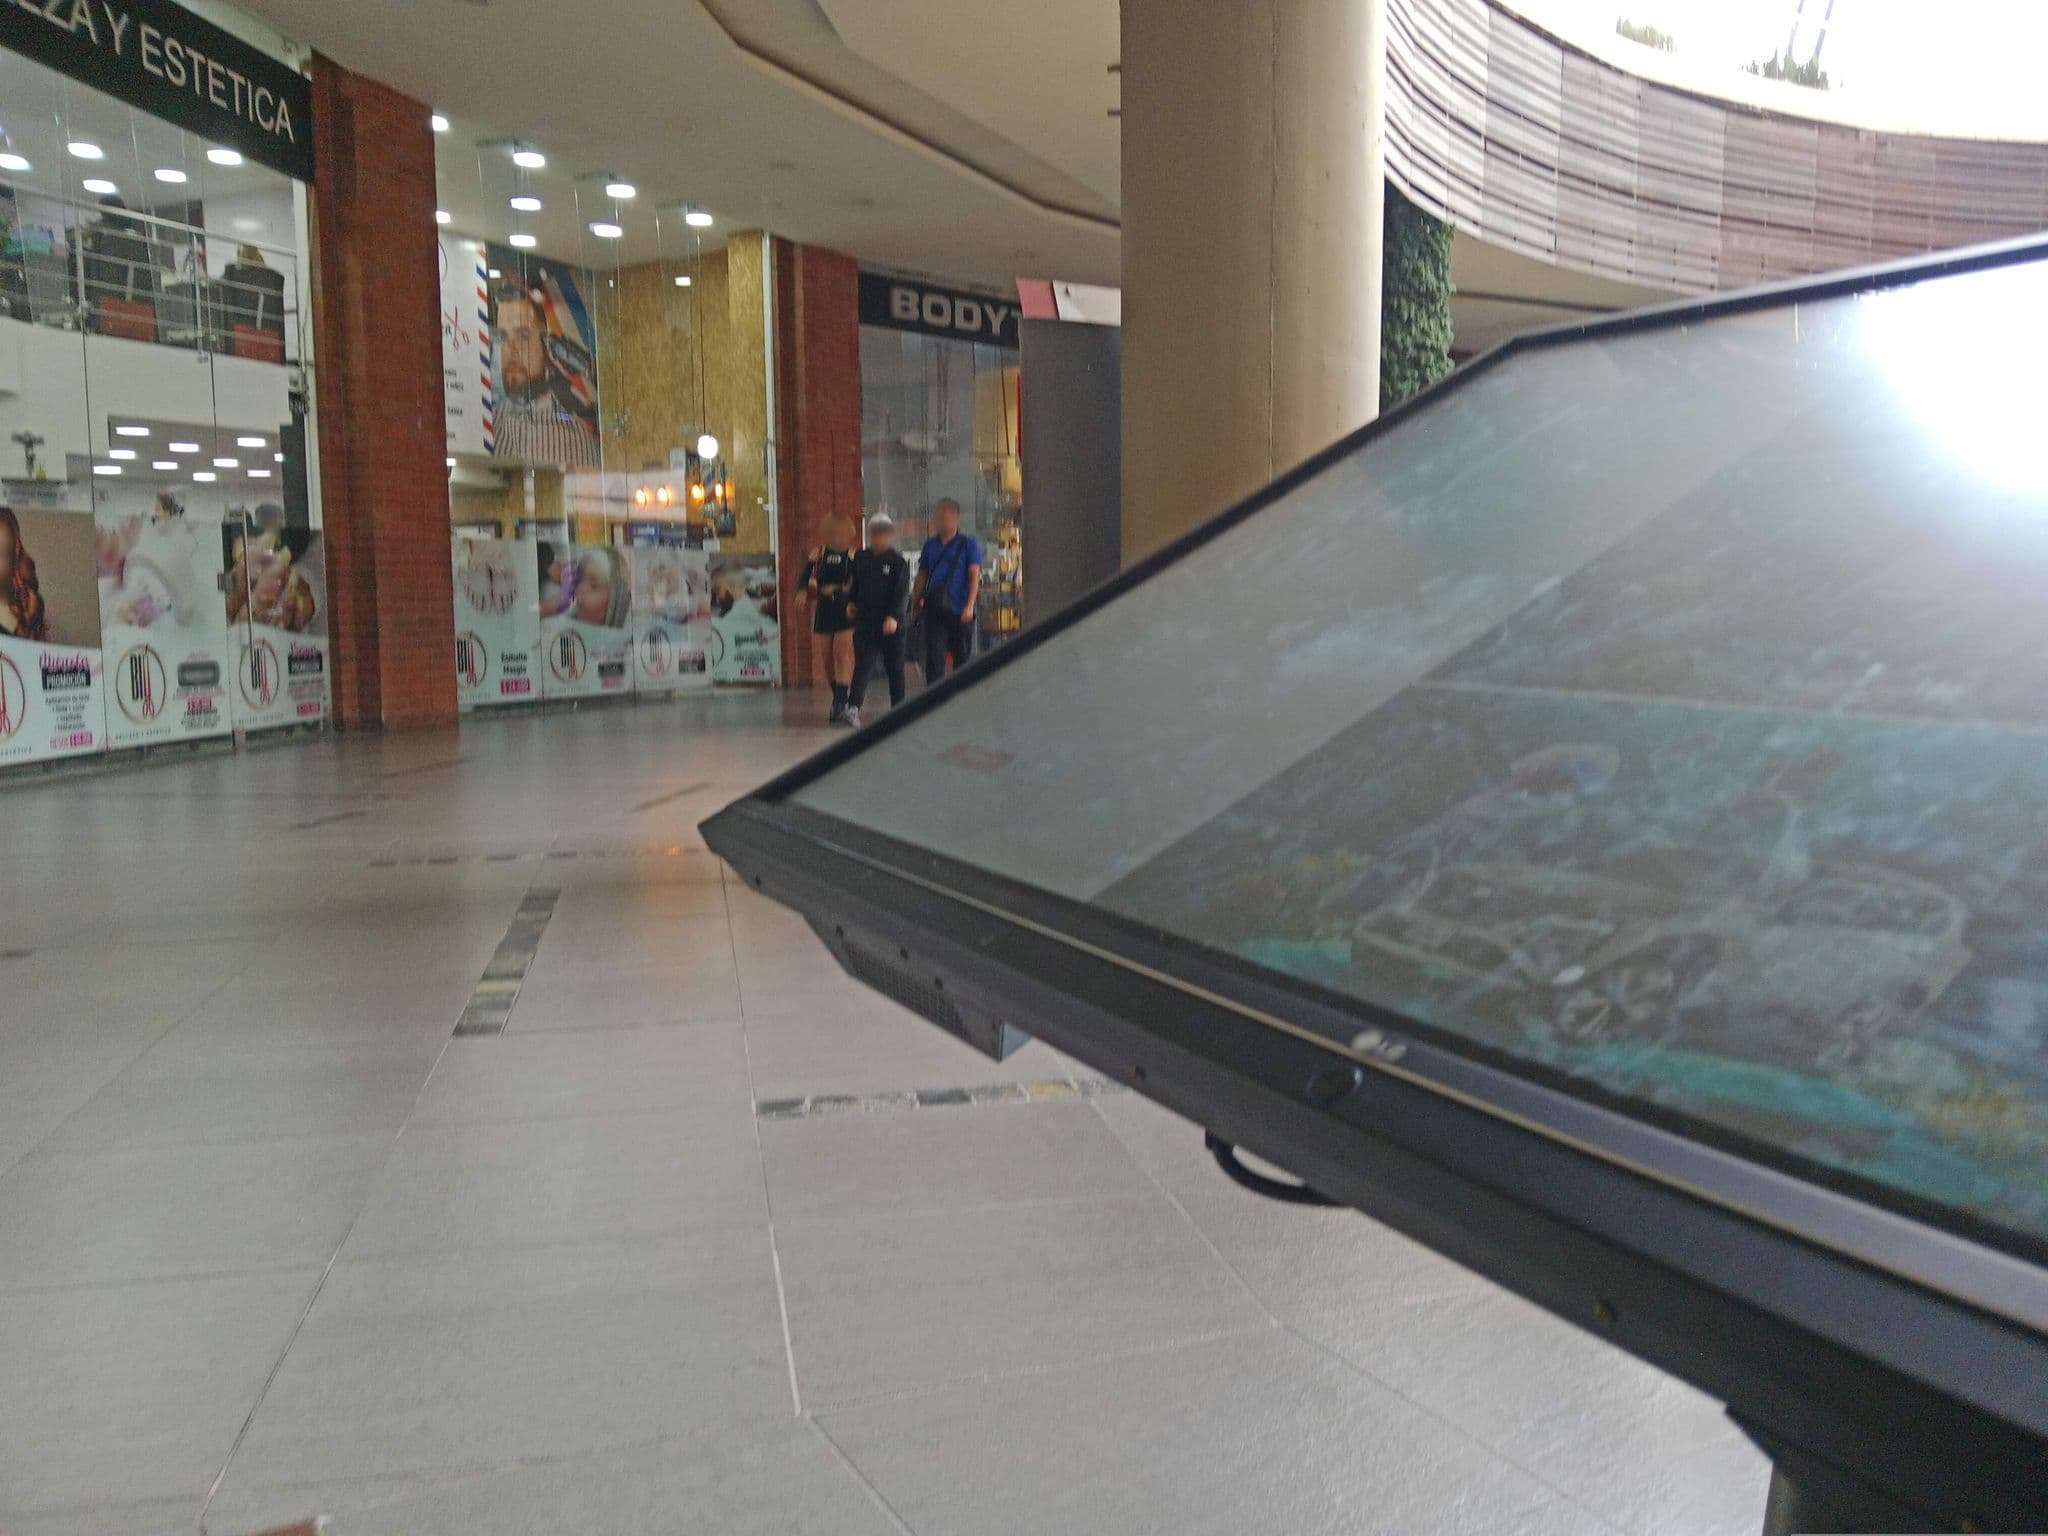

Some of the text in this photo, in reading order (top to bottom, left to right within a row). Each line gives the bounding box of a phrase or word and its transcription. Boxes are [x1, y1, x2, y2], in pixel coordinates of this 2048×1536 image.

[104, 2, 129, 55] Y
[139, 22, 296, 143] ESTETICA
[891, 286, 1021, 337] BODY
